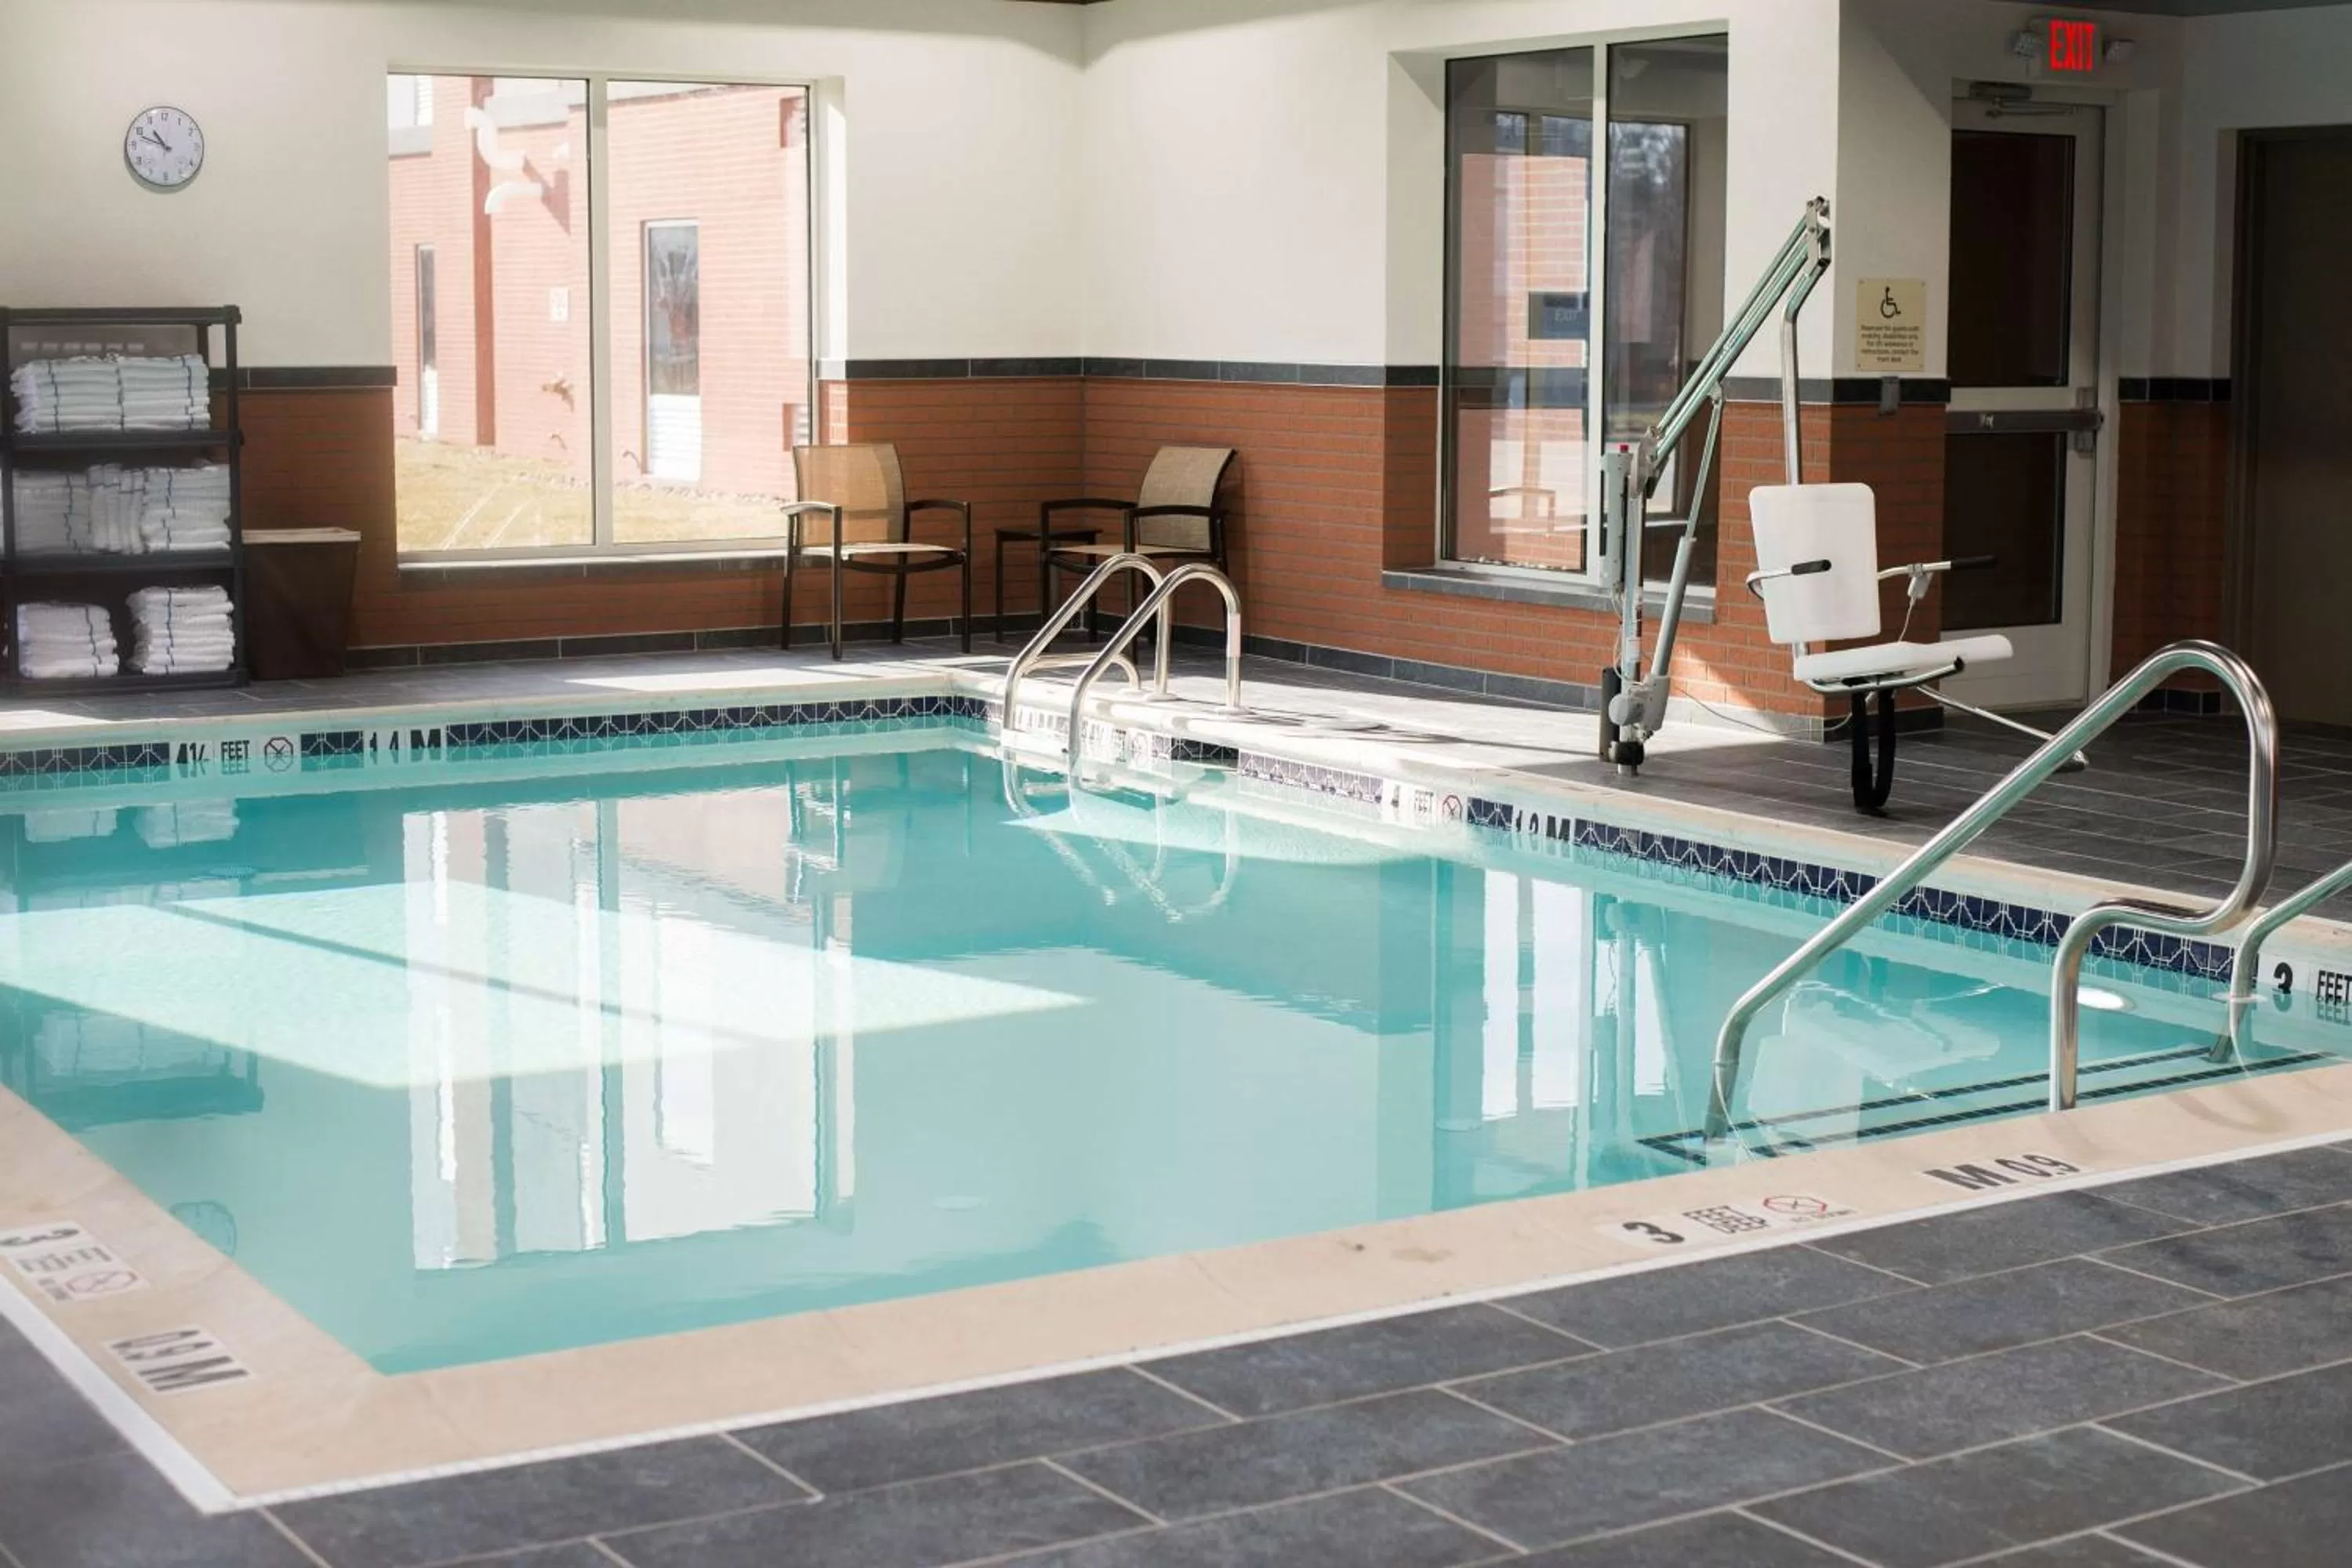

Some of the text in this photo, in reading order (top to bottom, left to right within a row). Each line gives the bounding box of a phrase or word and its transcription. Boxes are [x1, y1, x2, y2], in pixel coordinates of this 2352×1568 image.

[2049, 19, 2095, 71] EXIT
[221, 740, 250, 762] FEET
[1622, 1221, 1686, 1245] 3
